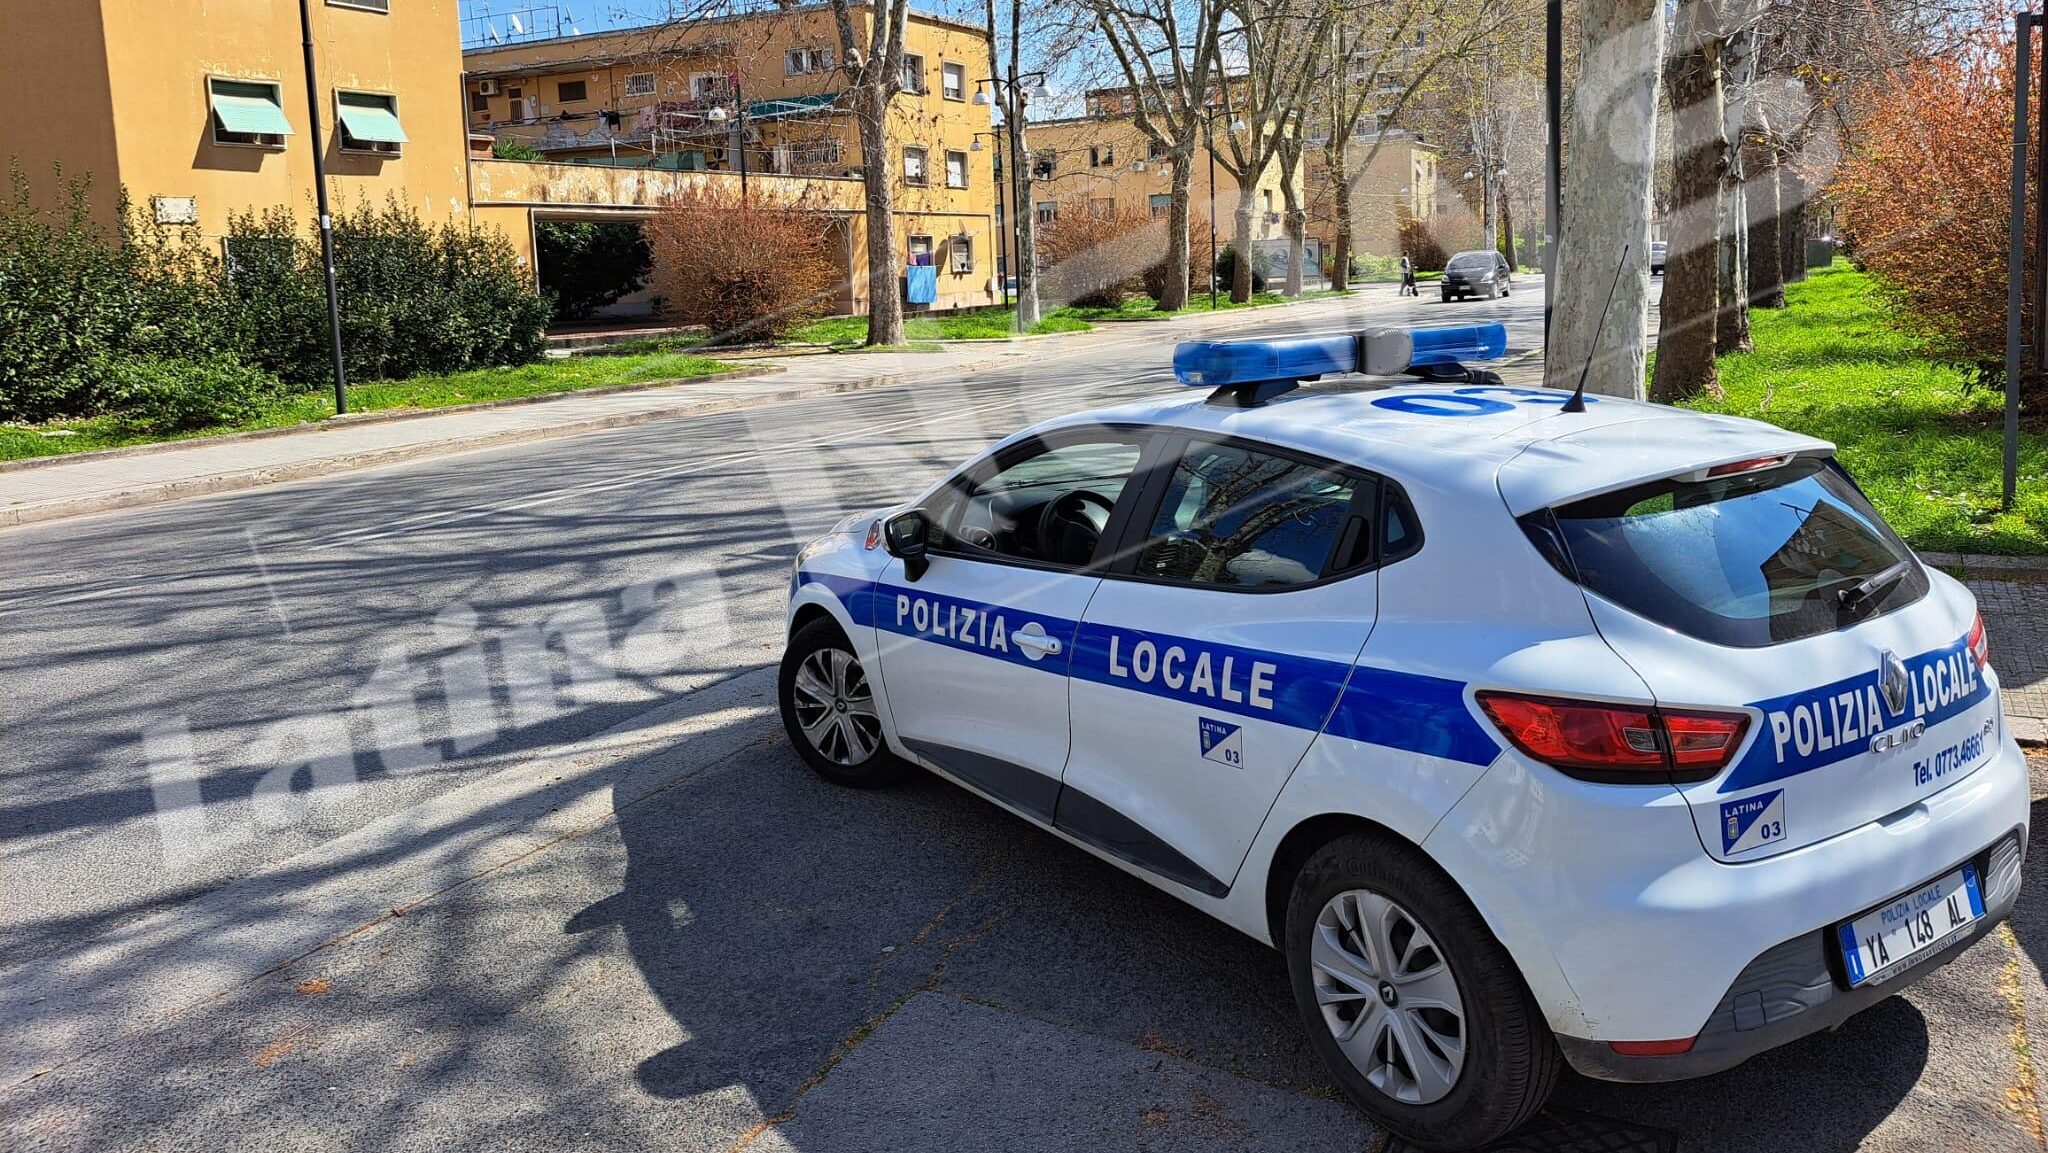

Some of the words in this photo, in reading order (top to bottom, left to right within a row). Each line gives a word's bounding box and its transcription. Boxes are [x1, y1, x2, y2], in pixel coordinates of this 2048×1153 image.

[896, 594, 1008, 653] POLIZIA
[1109, 635, 1278, 710] LOCALE
[1769, 684, 1884, 764] POLIZIA
[1911, 647, 1977, 717] LOCALE
[1202, 721, 1227, 735] LATINA
[1869, 719, 1926, 755] CLIO
[1225, 748, 1240, 764] 03
[1913, 758, 1932, 787] Tel.
[1725, 800, 1763, 818] LATINA
[1761, 820, 1781, 839] 03
[1880, 902, 1909, 926] POLIZIA
[1913, 885, 1942, 910] LOCALE
[1866, 932, 1890, 968] YA
[1905, 909, 1934, 949] 148
[1946, 894, 1966, 929] AL
